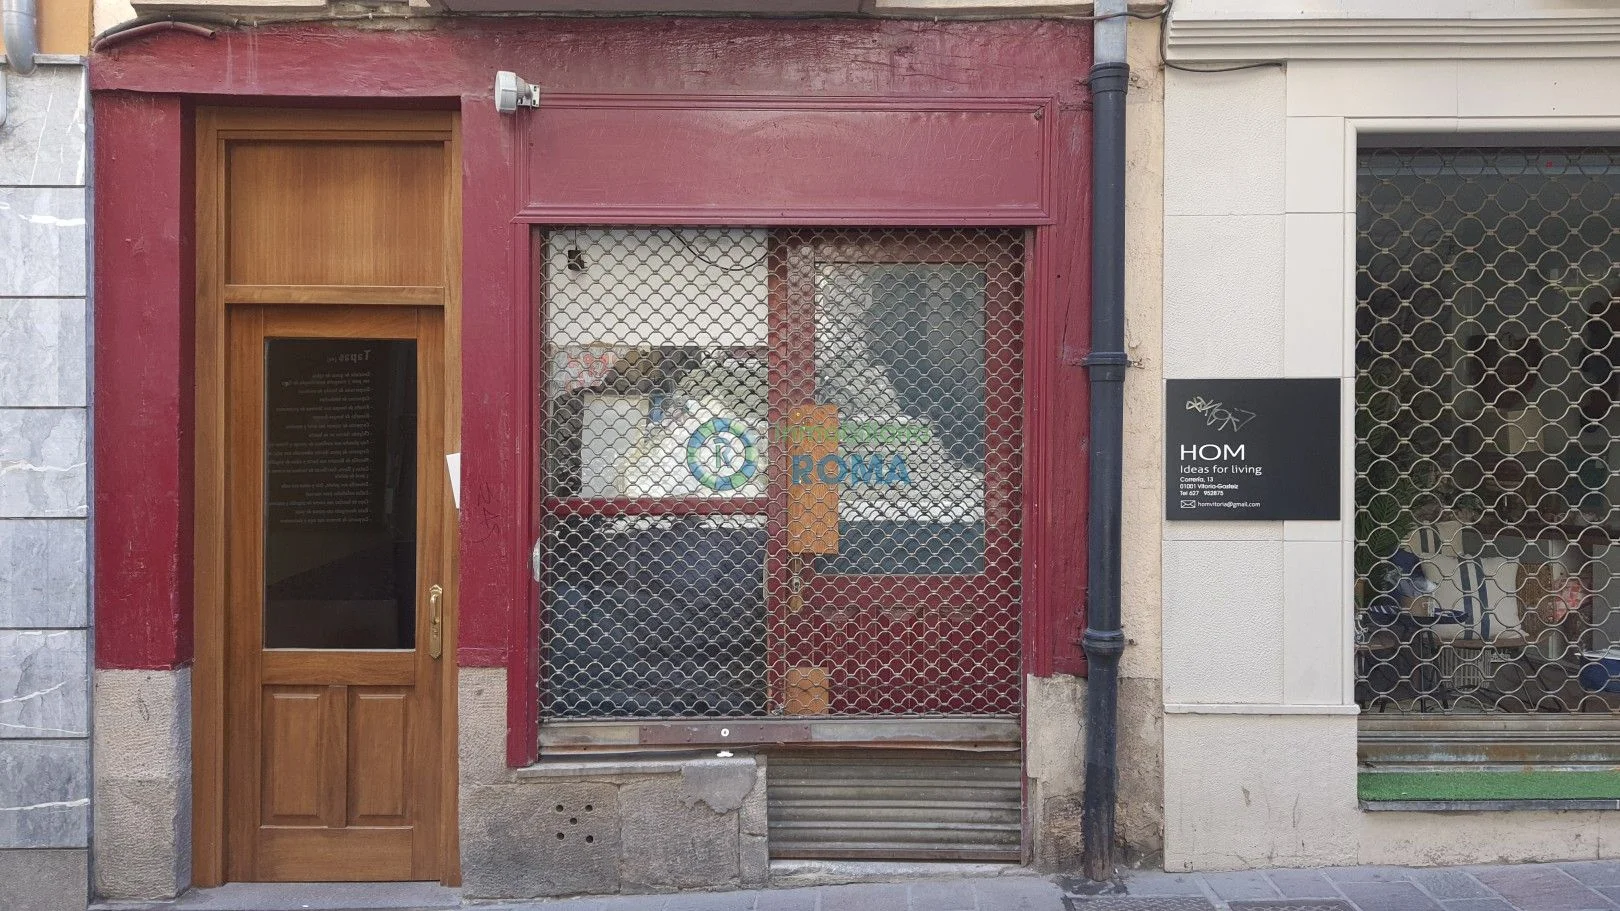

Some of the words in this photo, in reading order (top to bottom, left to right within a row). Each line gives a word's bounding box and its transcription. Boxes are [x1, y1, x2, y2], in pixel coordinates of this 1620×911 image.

[1180, 444, 1245, 461] HOM
[1180, 465, 1210, 474] Ideas
[1213, 464, 1228, 474] for
[1231, 464, 1262, 475] living
[1197, 500, 1261, 508] homvitoria@gmail.com
